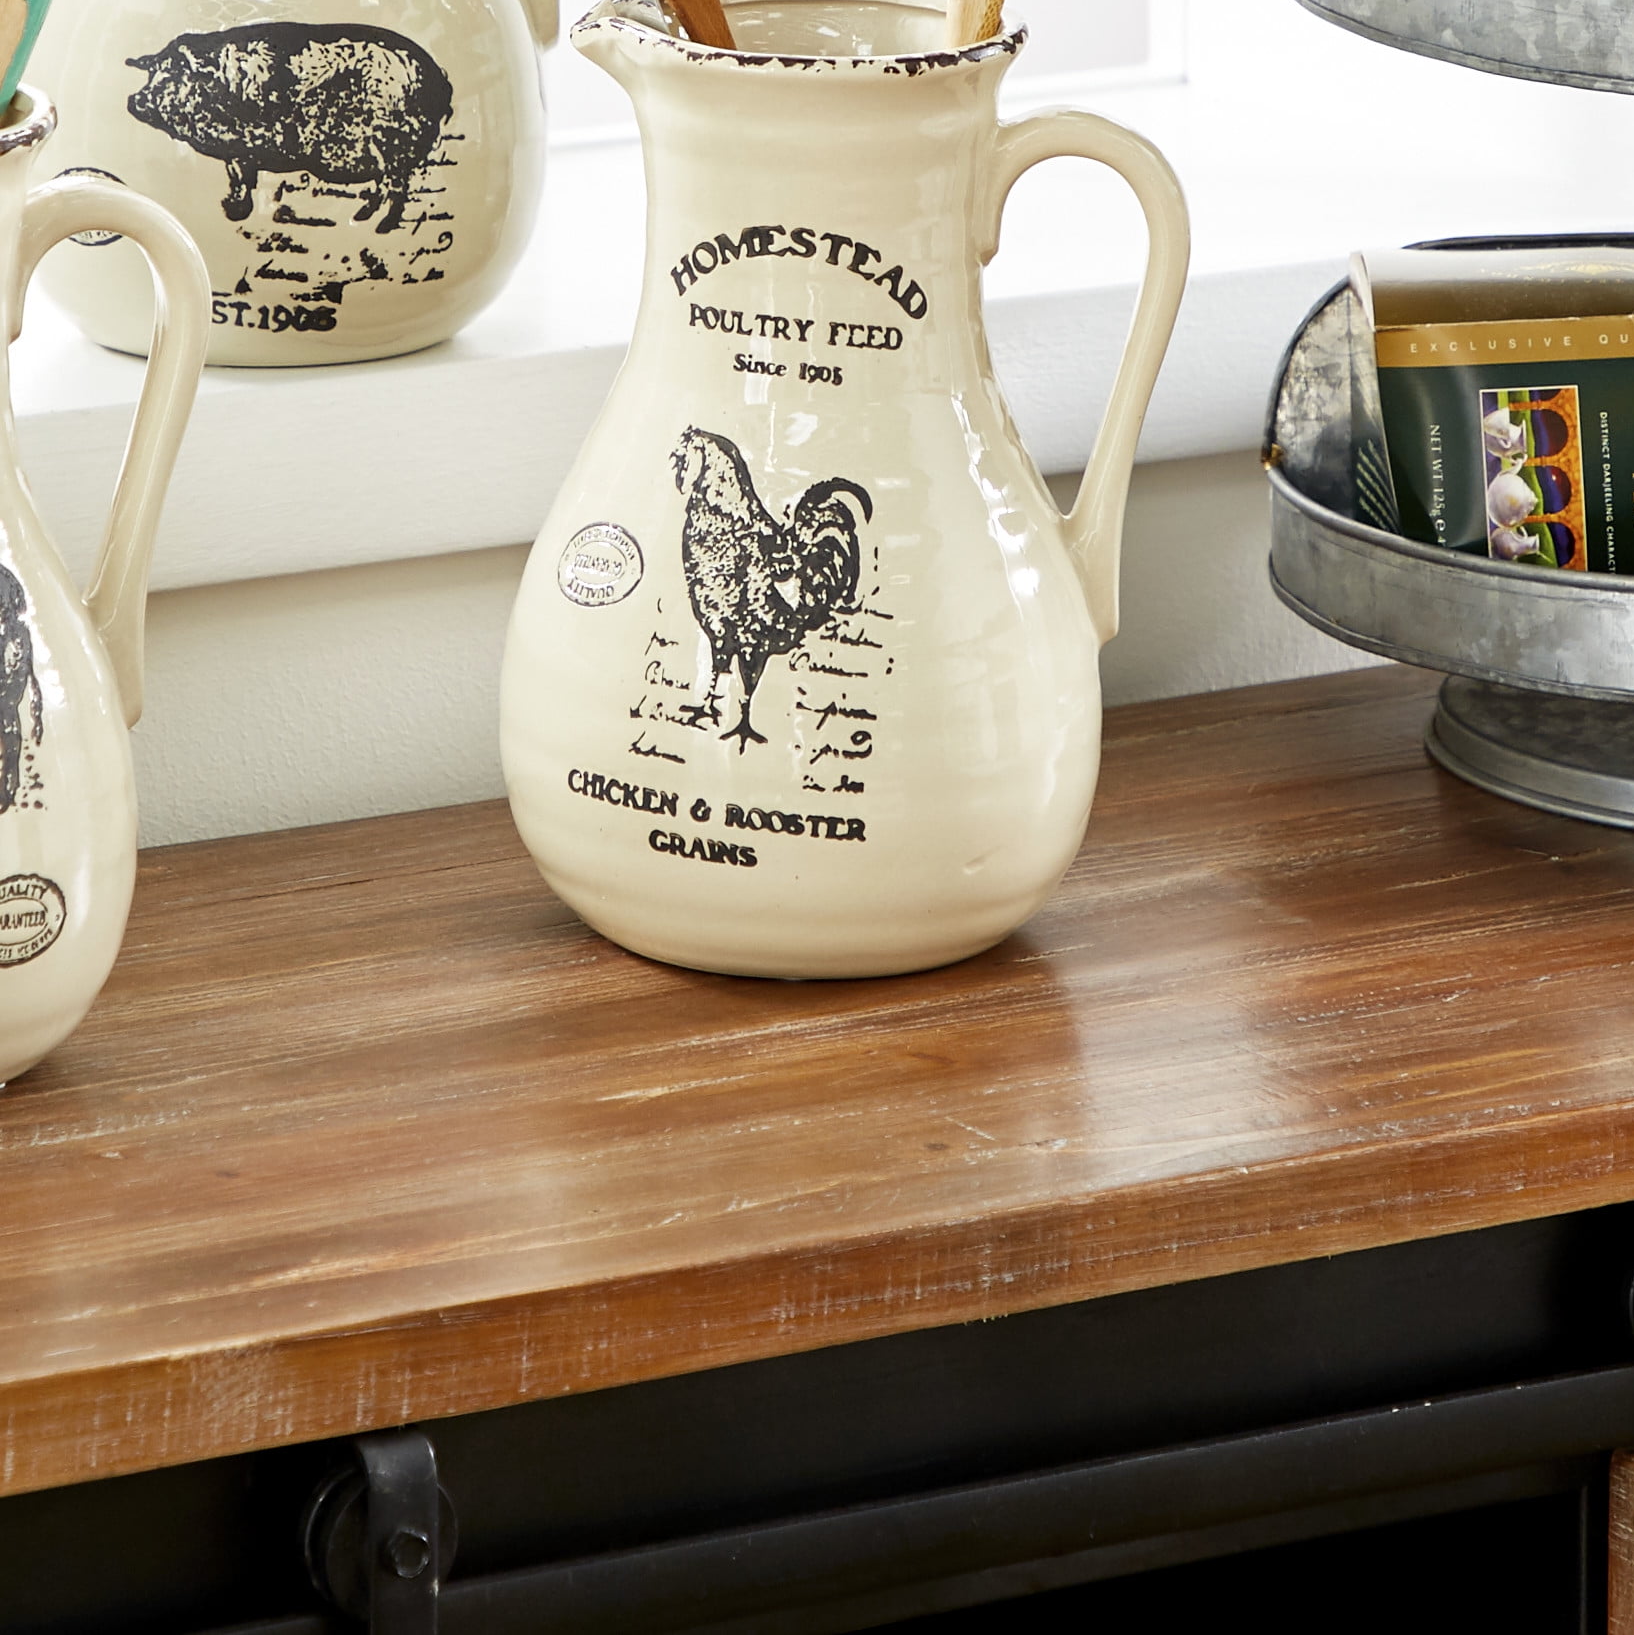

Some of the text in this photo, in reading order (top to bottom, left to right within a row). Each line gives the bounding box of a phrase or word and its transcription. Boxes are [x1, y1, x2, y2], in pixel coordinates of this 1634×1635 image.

[670, 225, 928, 320] HOMESTEAD
[689, 303, 904, 351] POULTRY FEED
[1410, 334, 1573, 354] EXCLUSIVE
[733, 353, 844, 386] Since 1905
[1429, 425, 1442, 454] NET
[1432, 459, 1445, 481] WT
[1599, 412, 1618, 574] DISTINCT DARJEELING CHARACT
[566, 578, 615, 599] QUALITY
[568, 769, 867, 842] CHICKEN & ROOSTER
[649, 829, 759, 868] GRAINS
[0, 883, 49, 900] UALITY
